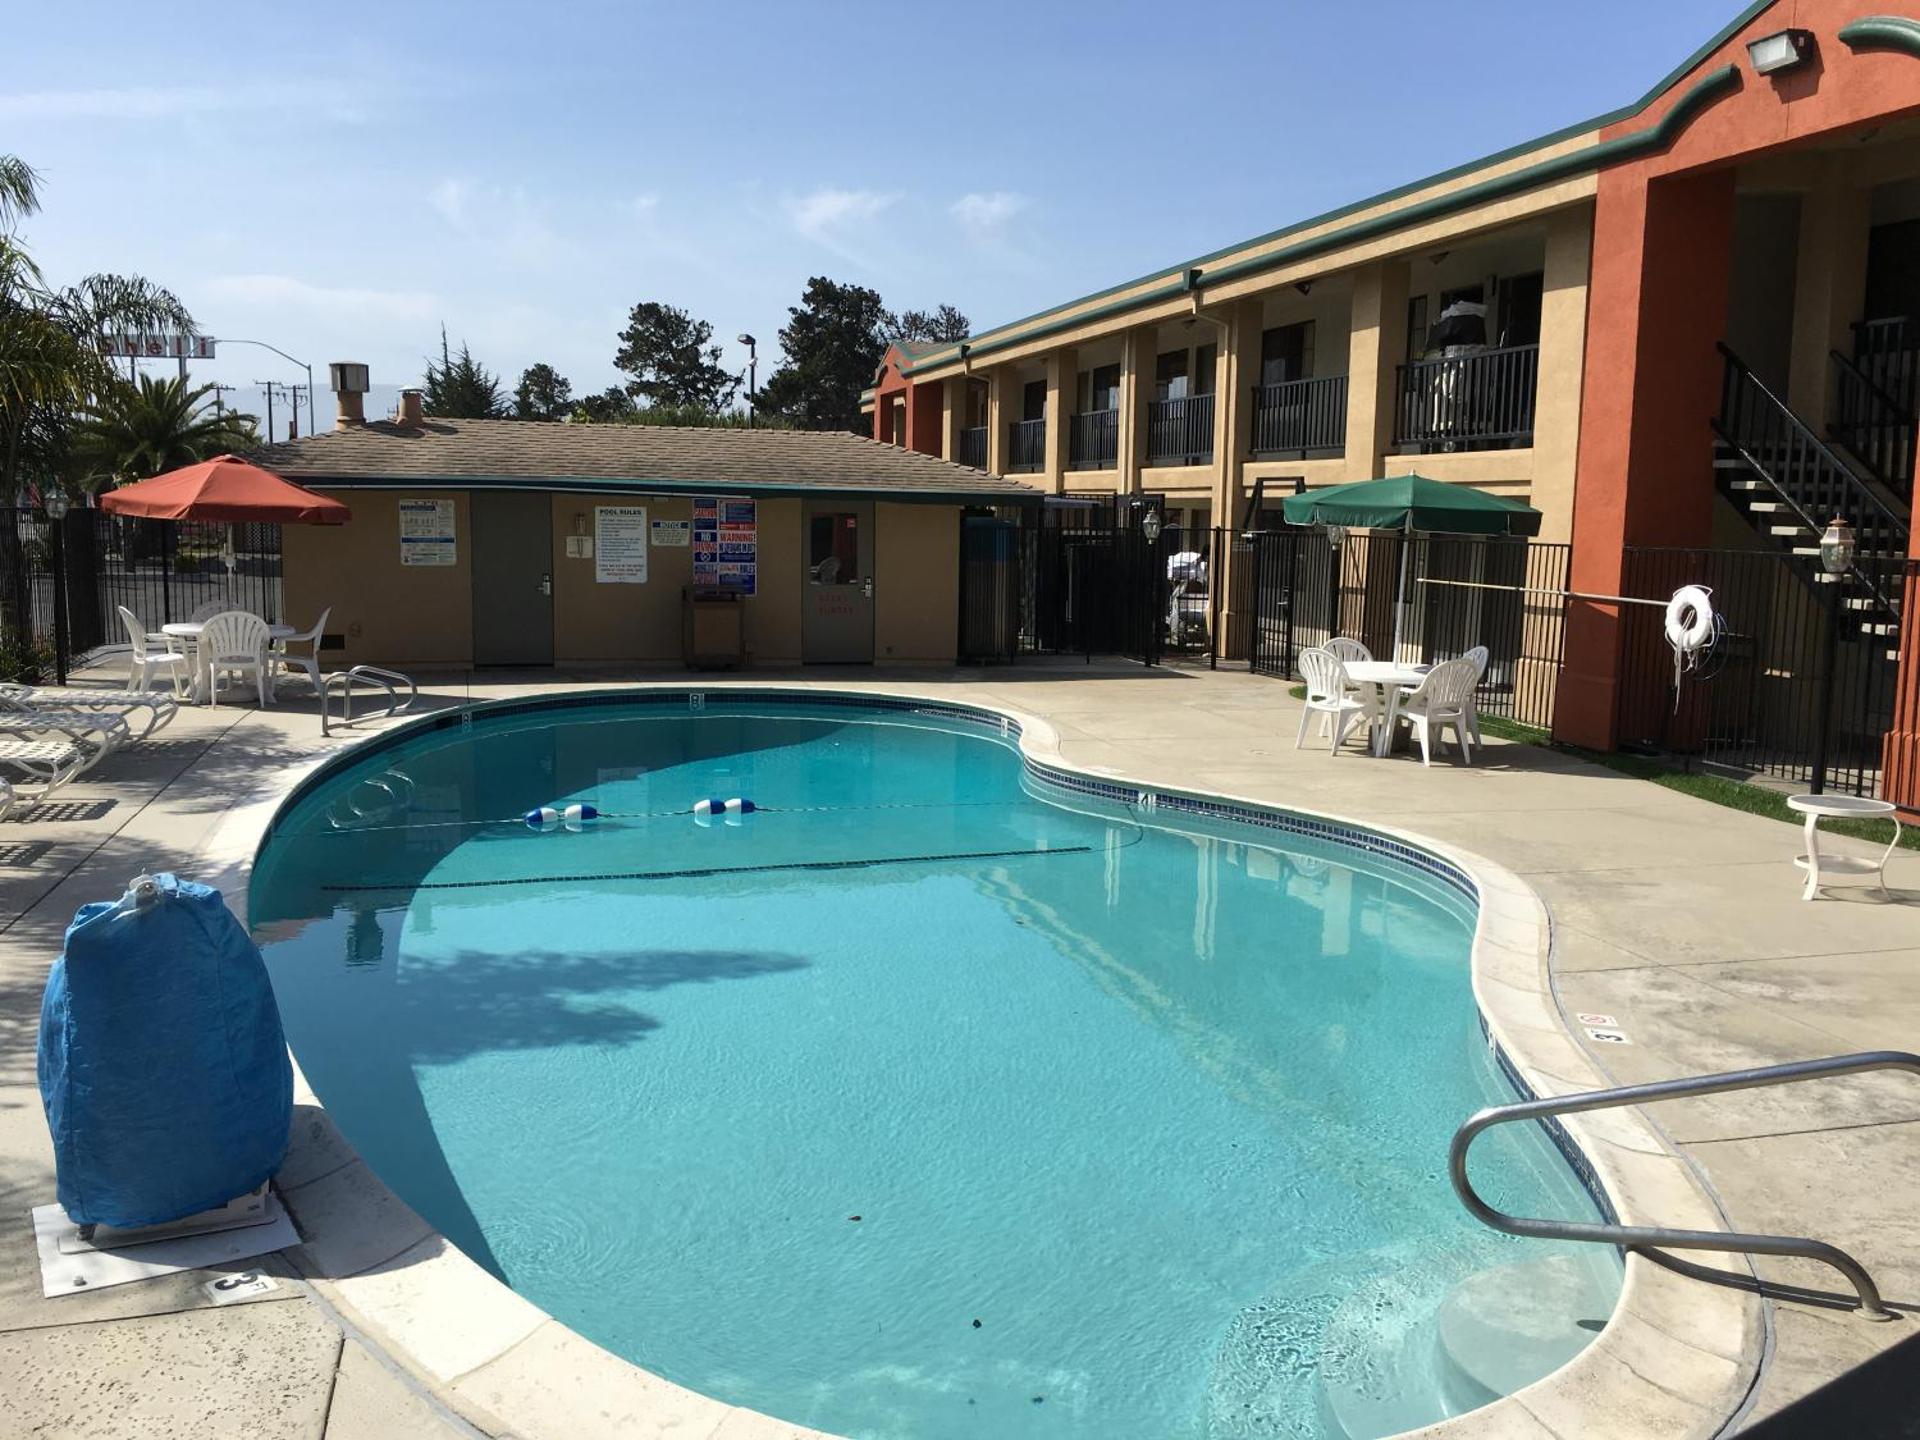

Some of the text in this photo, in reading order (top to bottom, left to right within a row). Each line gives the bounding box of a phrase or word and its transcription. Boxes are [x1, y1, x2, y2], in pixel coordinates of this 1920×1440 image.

[599, 508, 642, 516] POOL RULES
[660, 521, 681, 529] NOTICE
[701, 532, 711, 541] NO
[214, 1272, 259, 1291] 3
